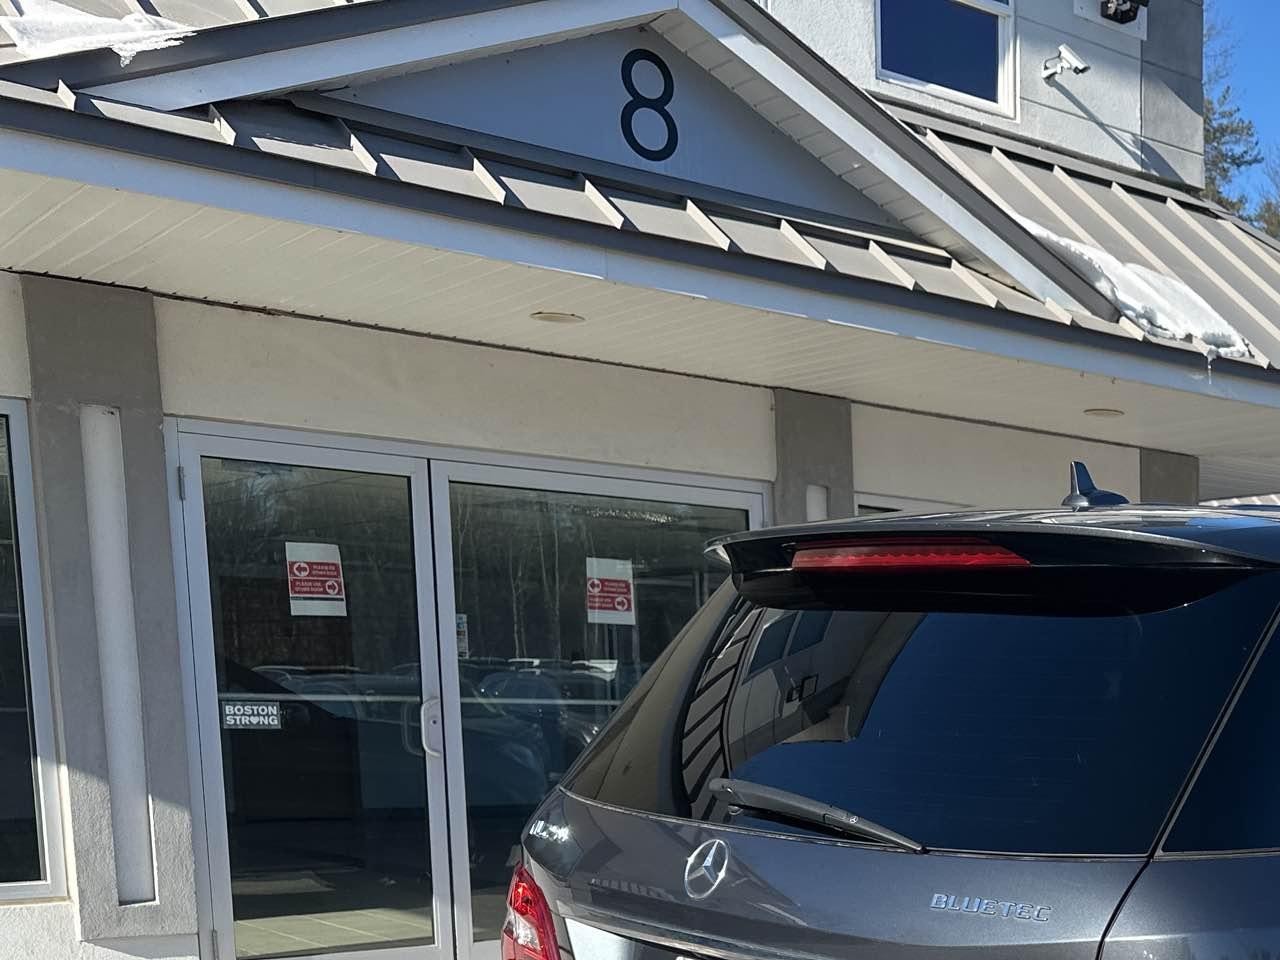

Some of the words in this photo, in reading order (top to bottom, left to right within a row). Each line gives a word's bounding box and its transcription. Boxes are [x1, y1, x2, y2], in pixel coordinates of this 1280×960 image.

[621, 48, 678, 161] 8
[225, 705, 277, 715] BOSTON
[930, 893, 1051, 921] BLUETEC
